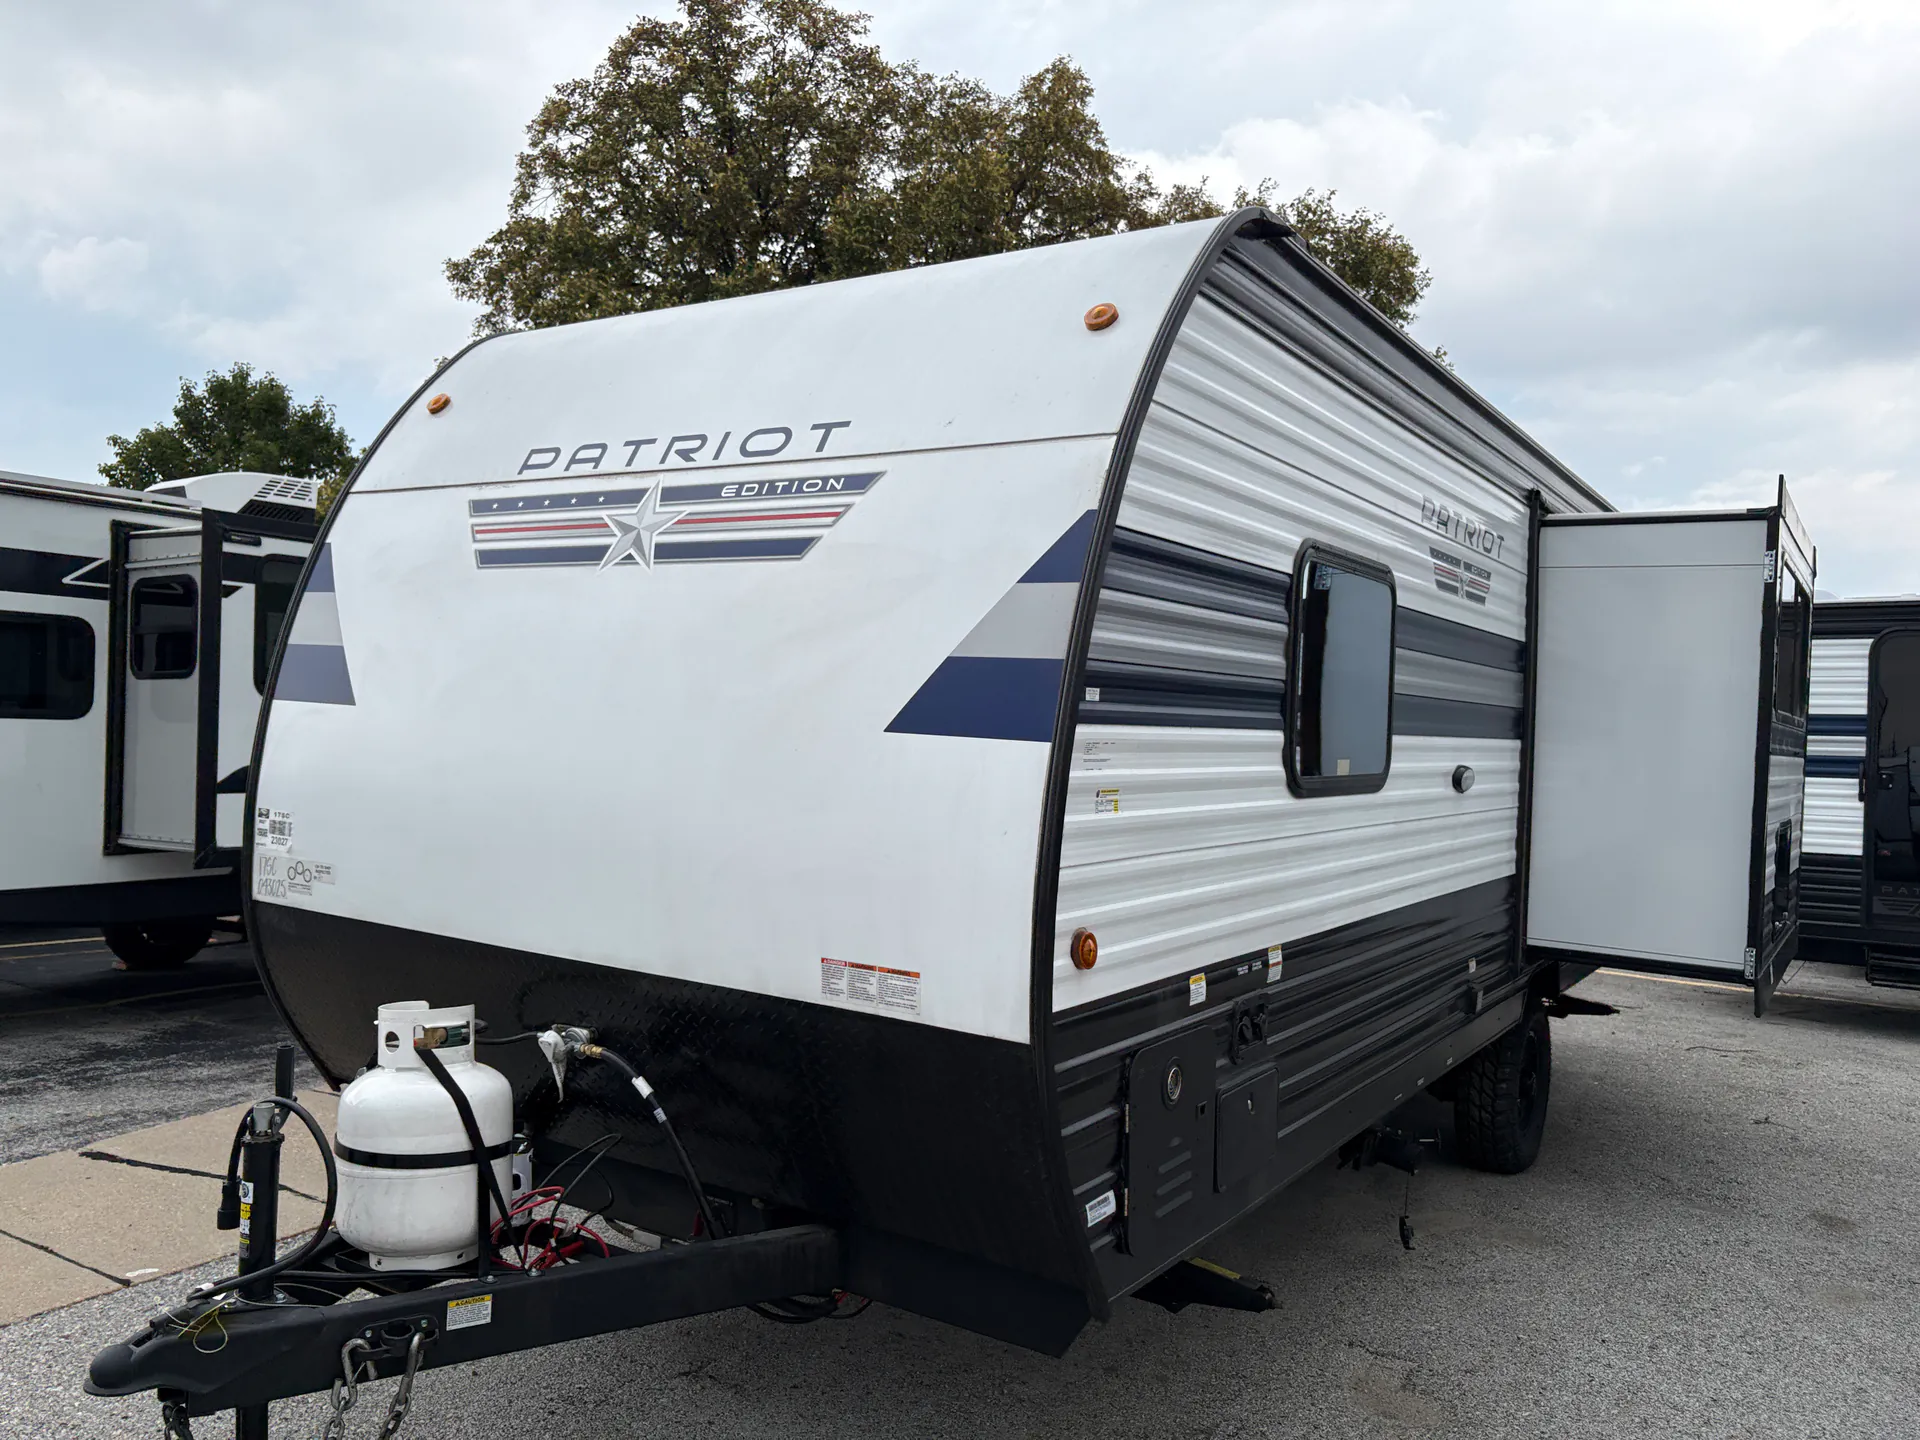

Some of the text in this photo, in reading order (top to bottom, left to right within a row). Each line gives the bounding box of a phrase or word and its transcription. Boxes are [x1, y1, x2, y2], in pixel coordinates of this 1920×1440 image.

[518, 420, 852, 475] PATRIOT
[720, 477, 846, 497] EDITION
[1421, 496, 1505, 559] PATRIOT
[460, 1297, 485, 1306] CAUTION
